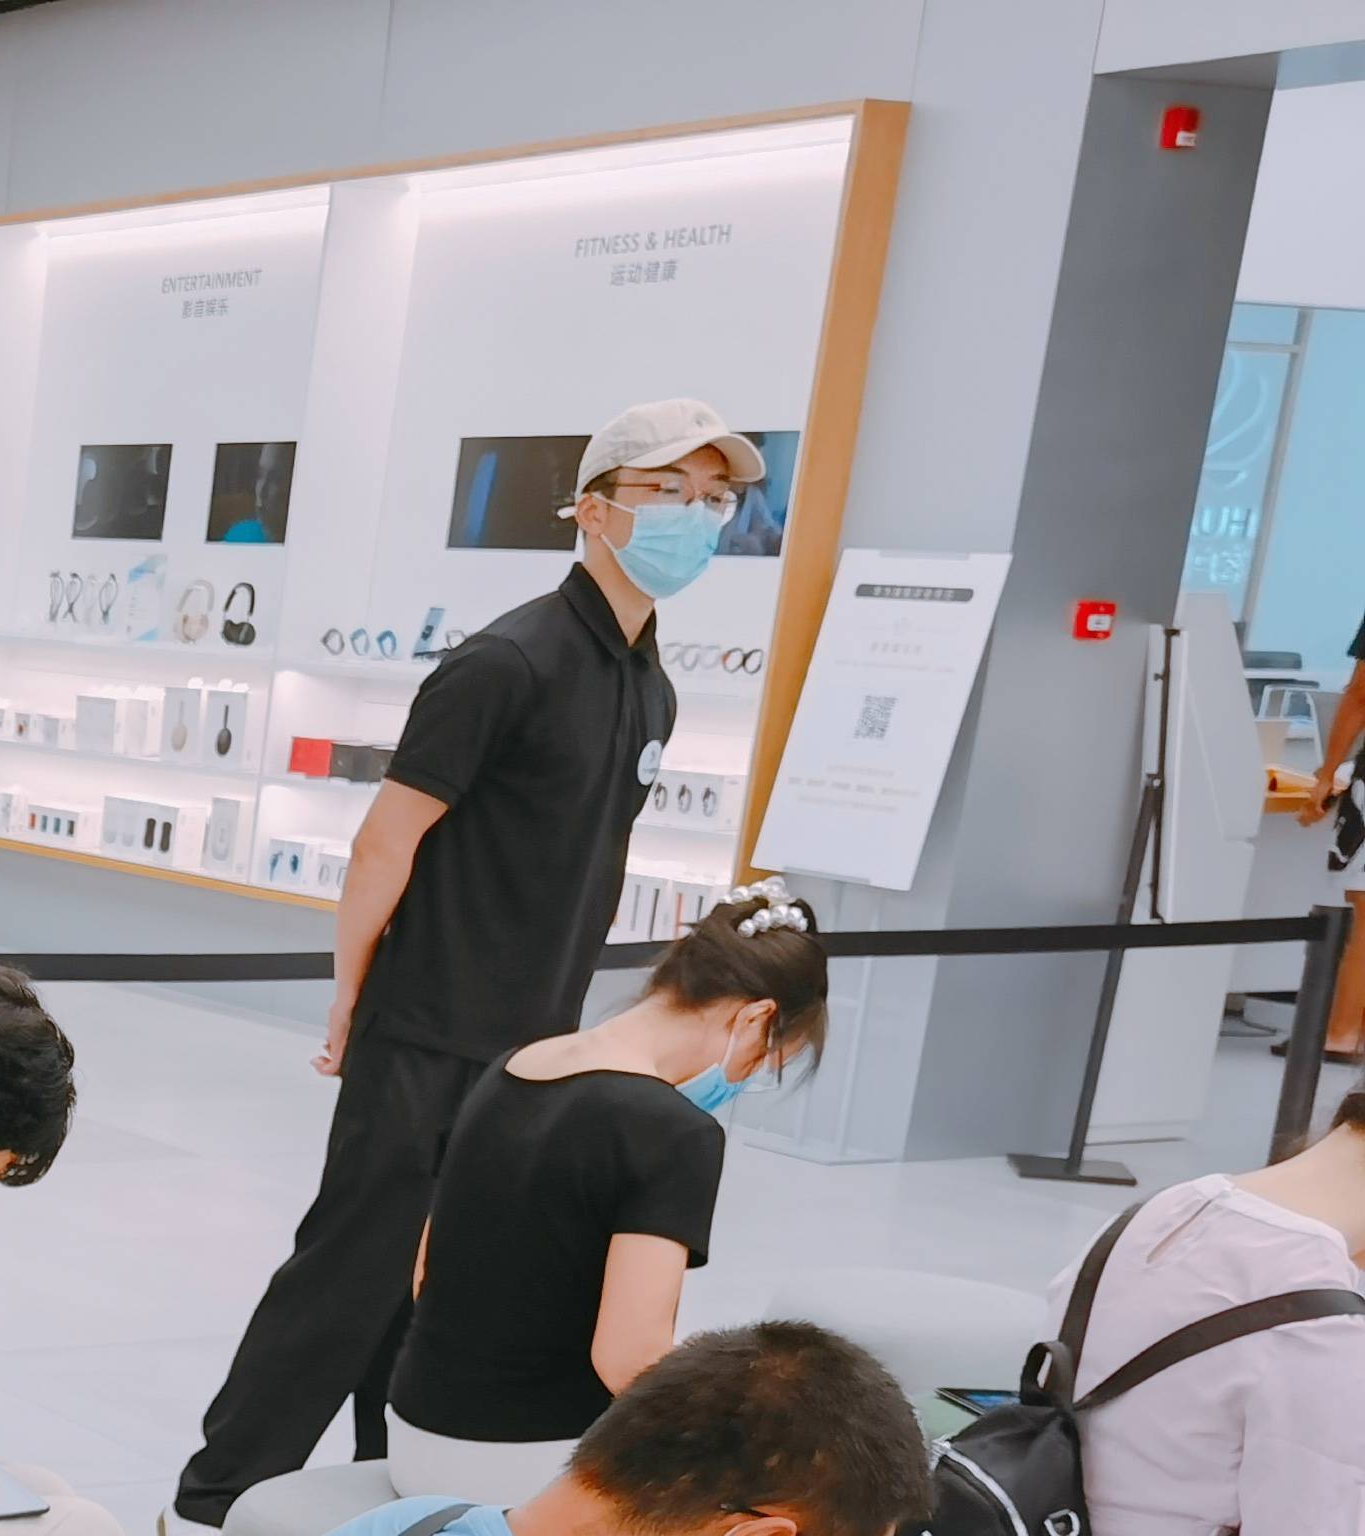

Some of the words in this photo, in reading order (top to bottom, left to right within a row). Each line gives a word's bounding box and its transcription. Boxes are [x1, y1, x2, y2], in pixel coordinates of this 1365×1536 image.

[574, 232, 640, 258] FITNESS
[644, 231, 658, 251] &
[663, 224, 732, 249] HEALTH
[161, 269, 262, 294] ENTERTAINMENT
[610, 259, 678, 286] 运动健康
